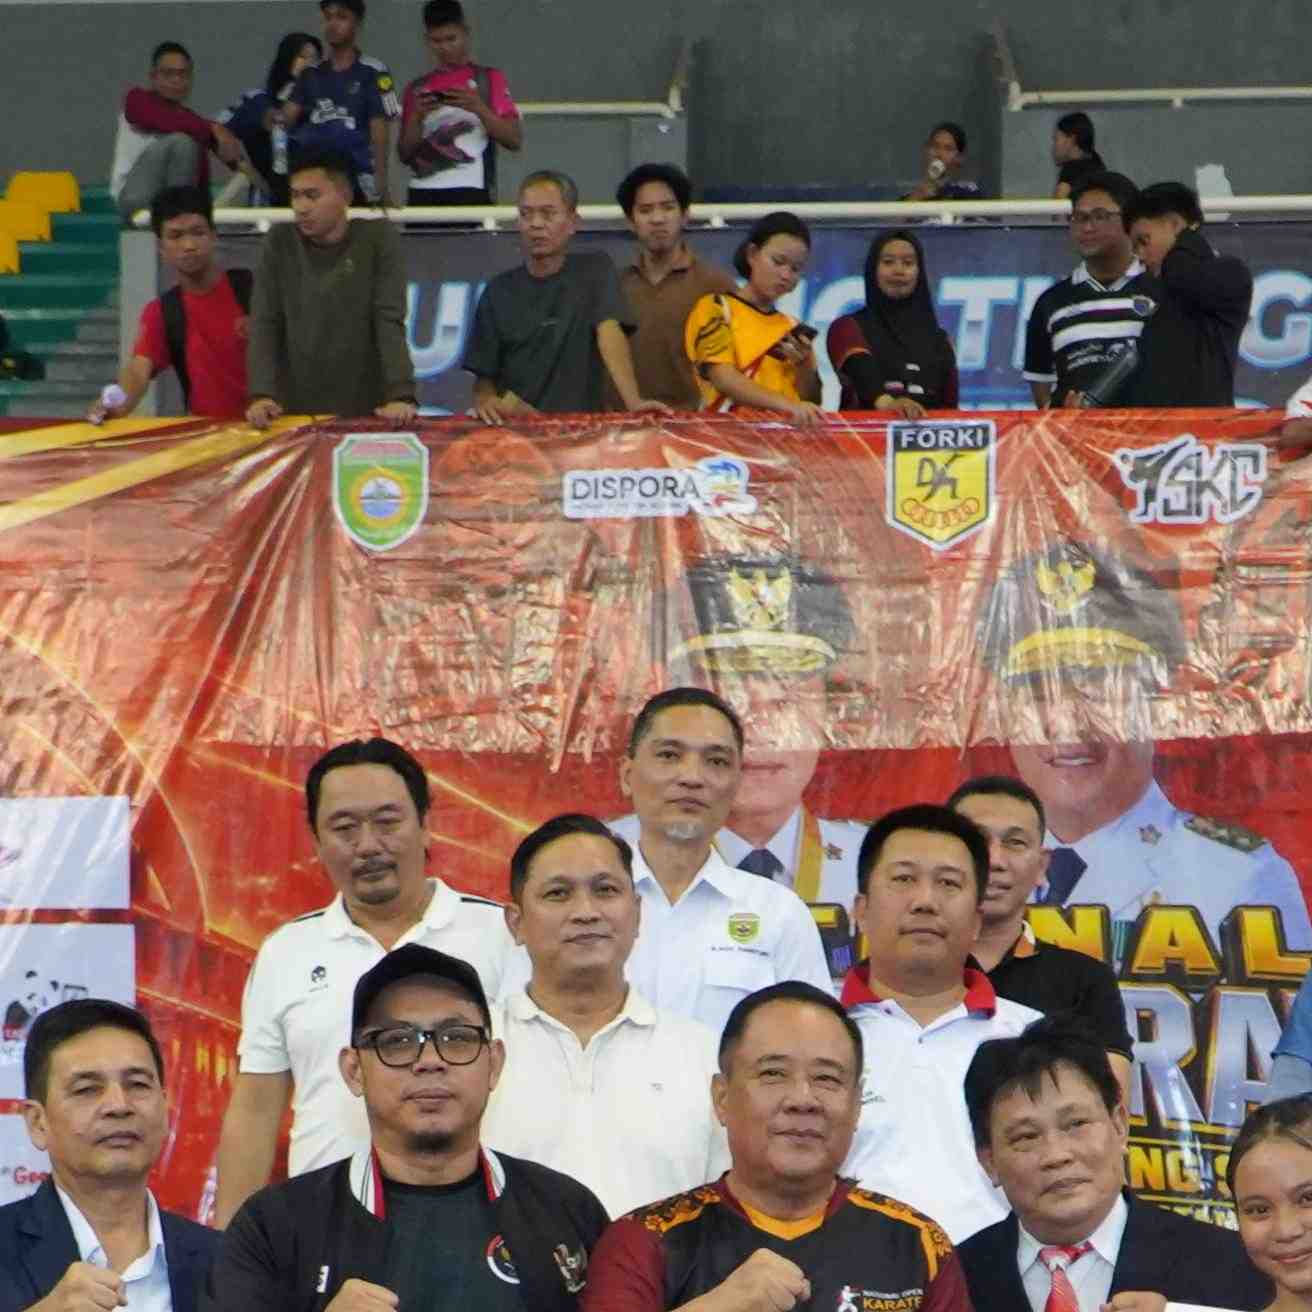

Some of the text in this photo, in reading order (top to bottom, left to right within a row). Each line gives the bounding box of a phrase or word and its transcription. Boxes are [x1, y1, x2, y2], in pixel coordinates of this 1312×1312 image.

[899, 427, 984, 450] FORKI
[572, 474, 702, 500] DISPORA
[863, 1296, 922, 1312] KARATE
